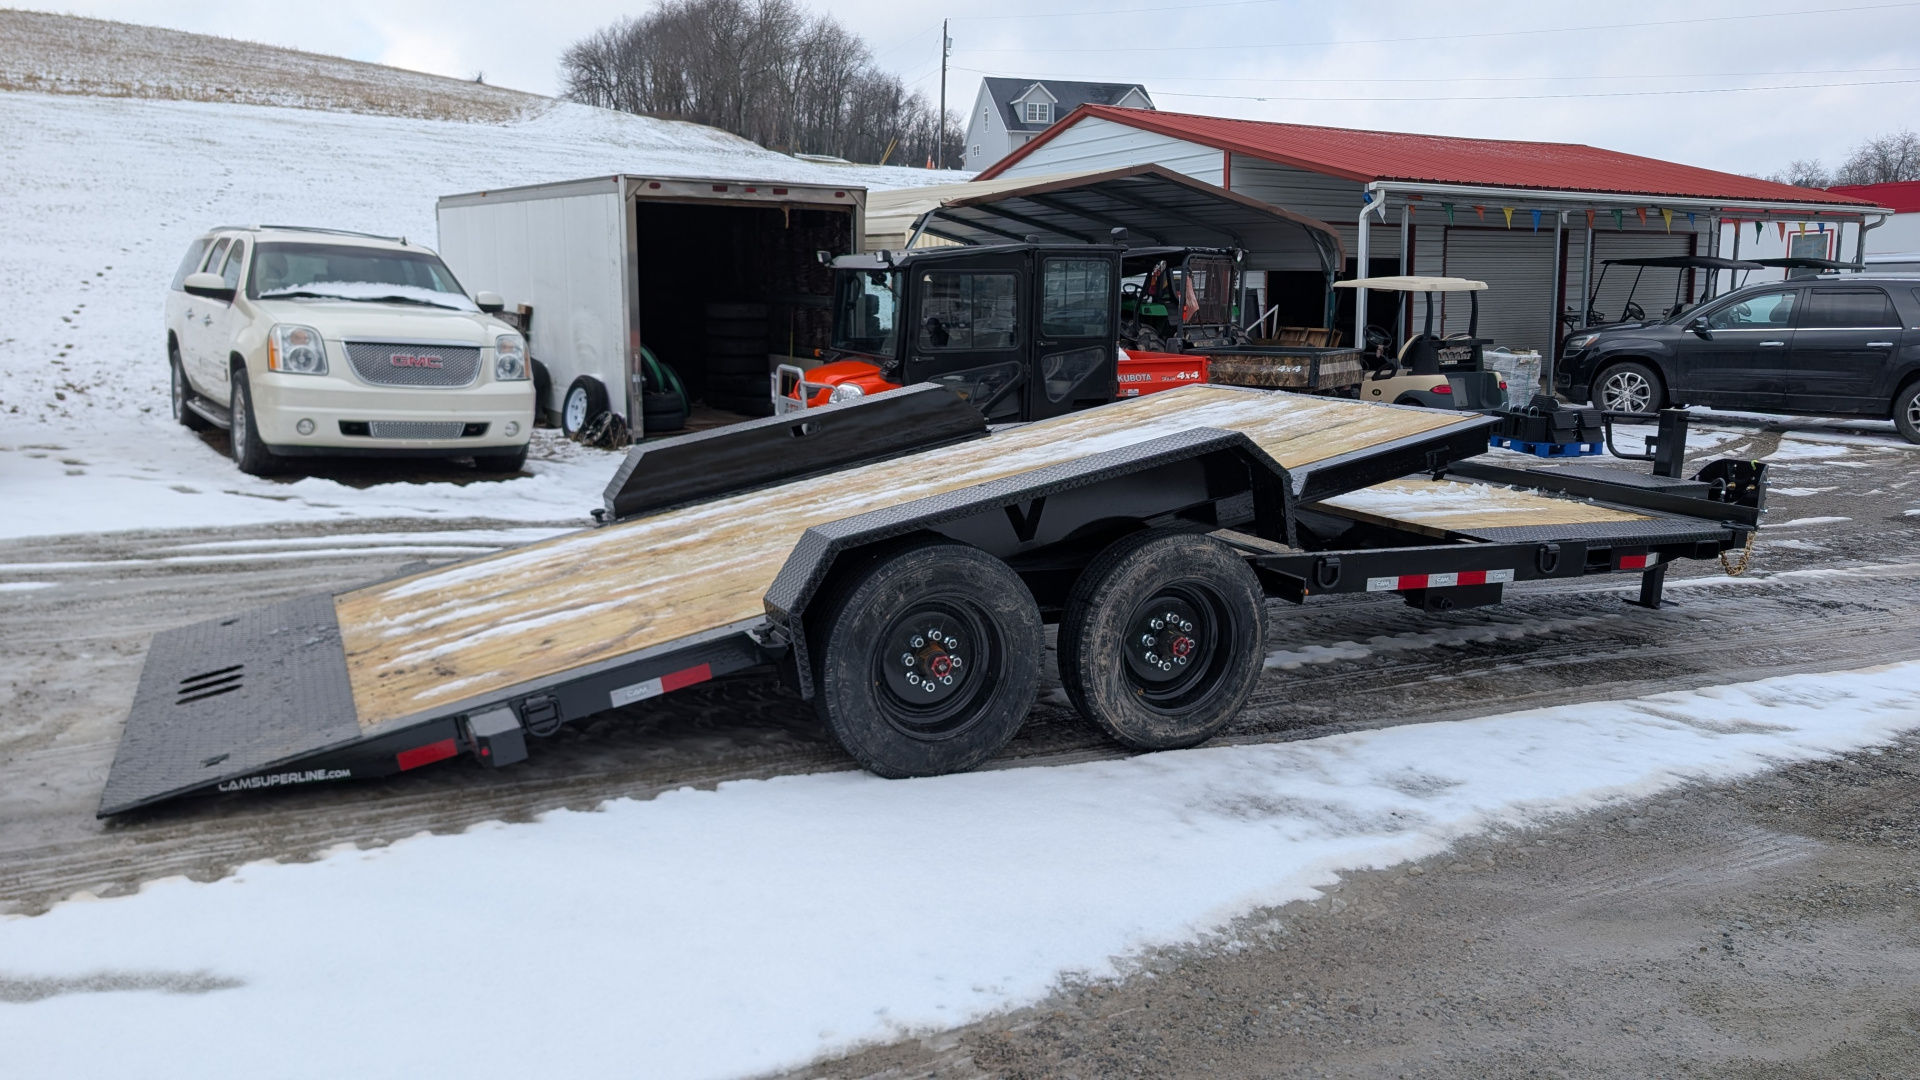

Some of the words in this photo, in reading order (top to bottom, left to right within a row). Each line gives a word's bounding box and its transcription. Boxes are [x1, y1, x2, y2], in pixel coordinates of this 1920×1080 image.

[391, 353, 444, 369] GMC
[1277, 365, 1302, 373] 4x4
[1117, 373, 1152, 383] KUBOTA
[1177, 370, 1200, 380] 4x4
[1493, 572, 1507, 580] CAM
[1376, 580, 1390, 588] CAM
[627, 686, 649, 697] CAM
